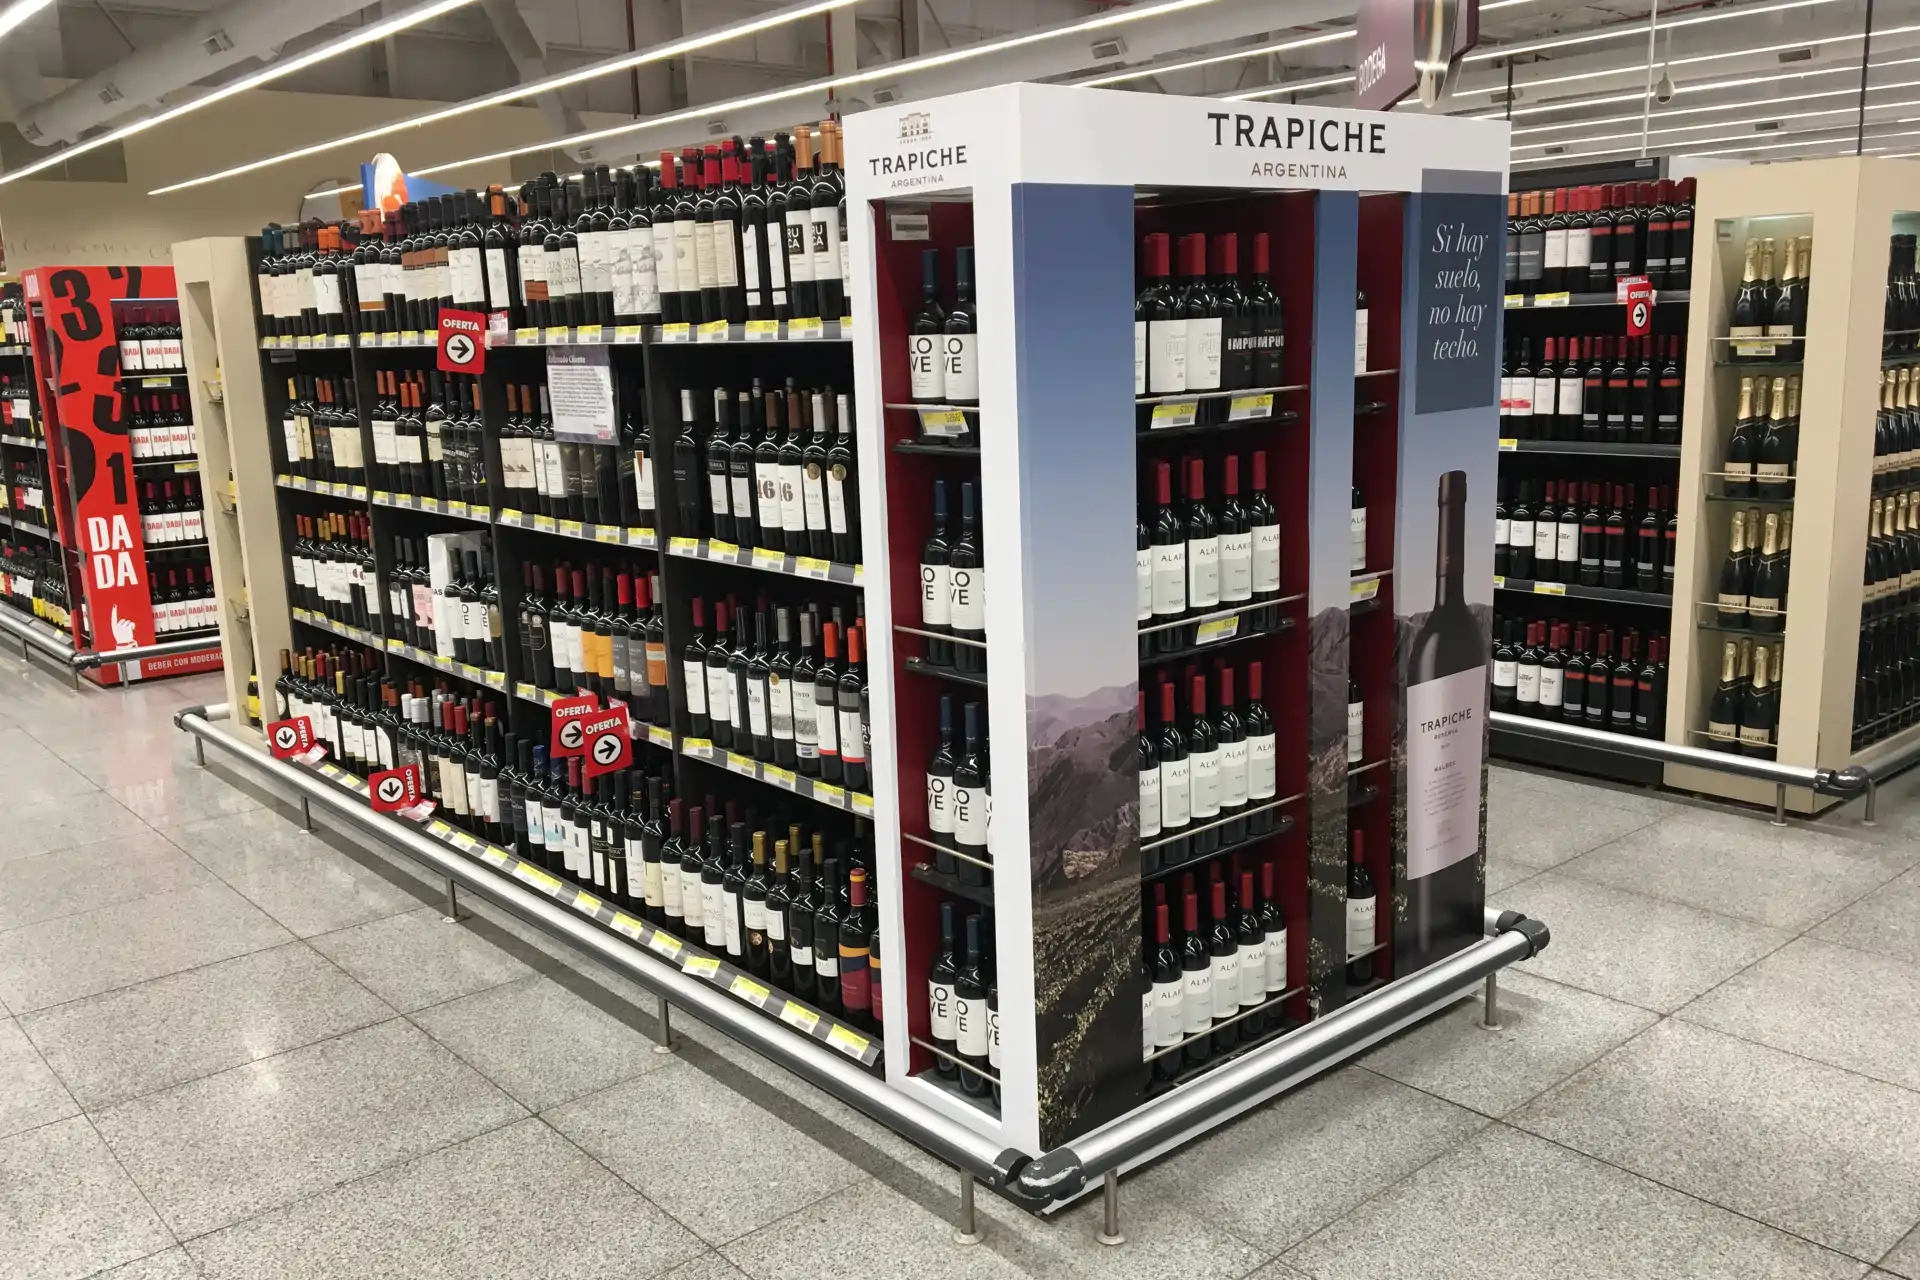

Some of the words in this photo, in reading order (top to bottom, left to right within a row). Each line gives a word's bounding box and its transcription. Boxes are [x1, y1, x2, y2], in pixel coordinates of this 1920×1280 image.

[1207, 112, 1385, 154] TRAPICHE
[869, 145, 967, 175] TRAPICHE
[1251, 162, 1347, 179] ARGENTINA
[891, 174, 944, 189] ARGENTINA
[1432, 223, 1454, 253] Si
[1456, 222, 1489, 261] hay
[1435, 259, 1481, 292] suelo,
[442, 318, 480, 332] OFERTA
[1429, 305, 1450, 325] no
[1454, 294, 1487, 331] hay
[1433, 328, 1479, 360] techo.
[911, 356, 931, 372] VE
[106, 452, 128, 505] 1
[88, 514, 133, 552] DA
[148, 660, 172, 671] BEBER
[174, 656, 189, 667] CON
[556, 705, 593, 717] OFERTA
[1421, 708, 1472, 733] TRAPICHE
[297, 720, 308, 748] OFERTA
[585, 717, 622, 735] OFERTA
[405, 769, 416, 801] OFERTA
